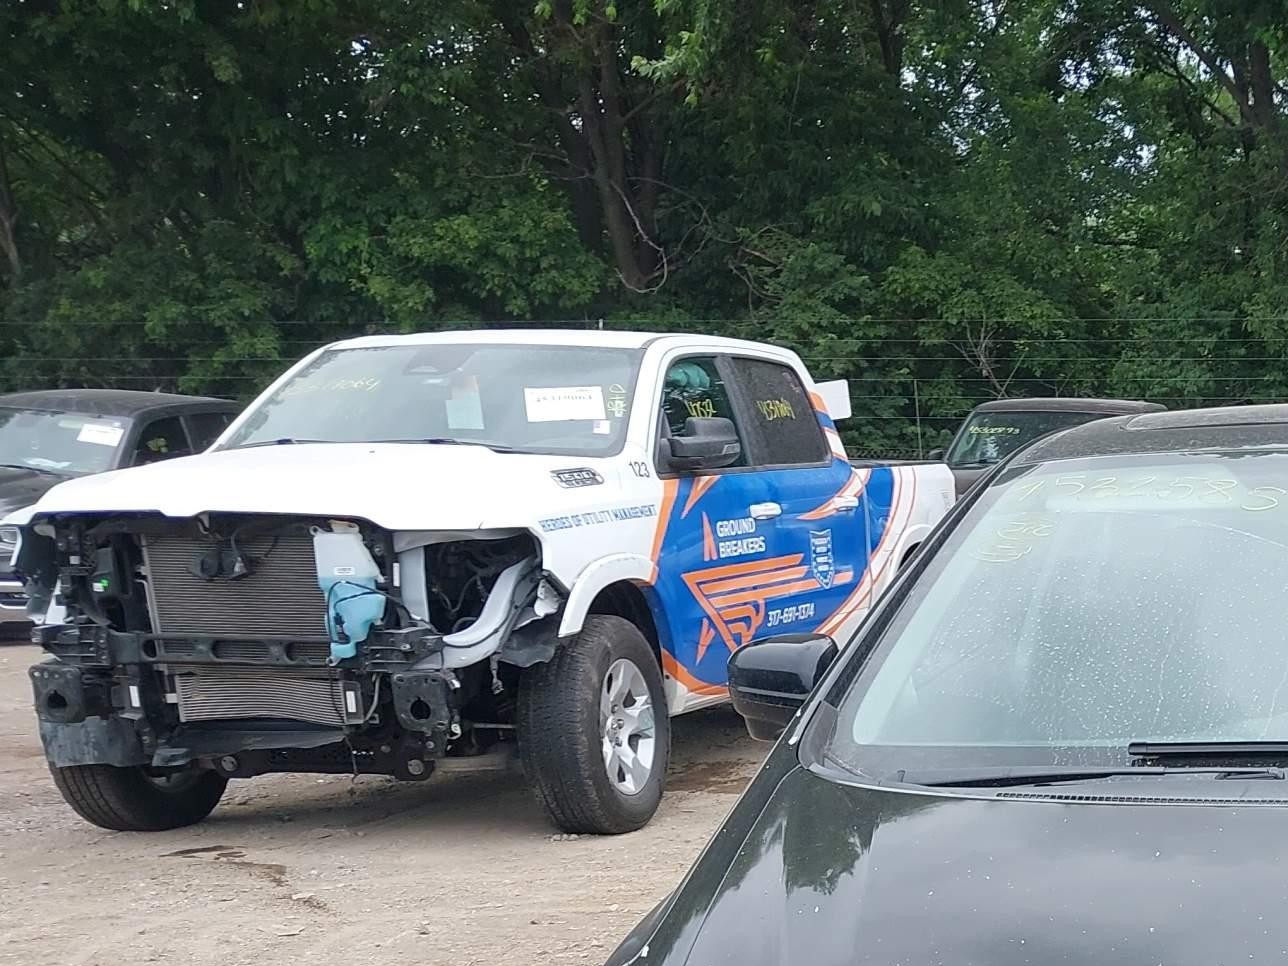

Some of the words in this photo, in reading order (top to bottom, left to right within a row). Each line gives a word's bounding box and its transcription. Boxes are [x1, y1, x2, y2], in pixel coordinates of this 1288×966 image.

[628, 460, 650, 478] 123
[716, 517, 756, 538] GROUND
[719, 536, 766, 559] BREAKERS
